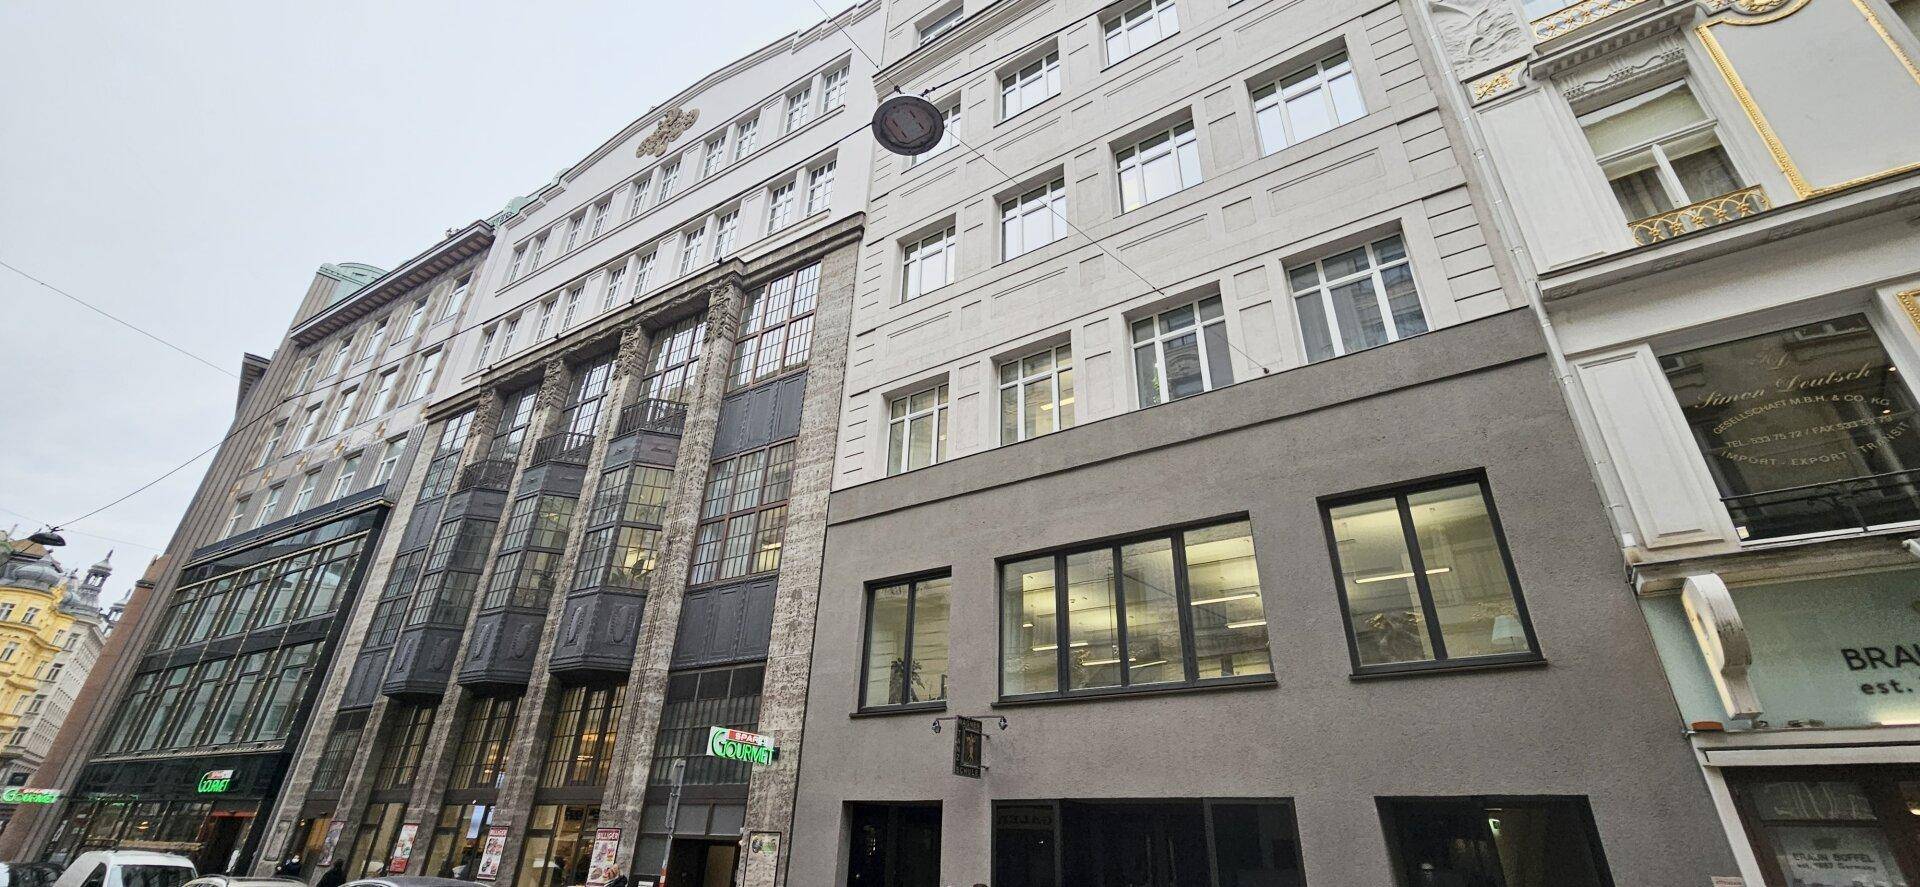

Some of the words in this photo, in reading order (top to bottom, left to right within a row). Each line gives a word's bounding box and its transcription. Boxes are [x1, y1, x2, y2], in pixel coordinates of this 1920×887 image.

[1694, 388, 1765, 409] Simon
[1775, 362, 1871, 392] Deutsch
[1713, 400, 1787, 435] GESELLSCHAFT
[1871, 397, 1890, 406] KG
[1721, 450, 1776, 465] IMPORT
[1791, 451, 1847, 466] EXPORT
[1859, 421, 1909, 453] TRANSIT
[1861, 679, 1913, 695] est.
[712, 728, 774, 766] GOURMET
